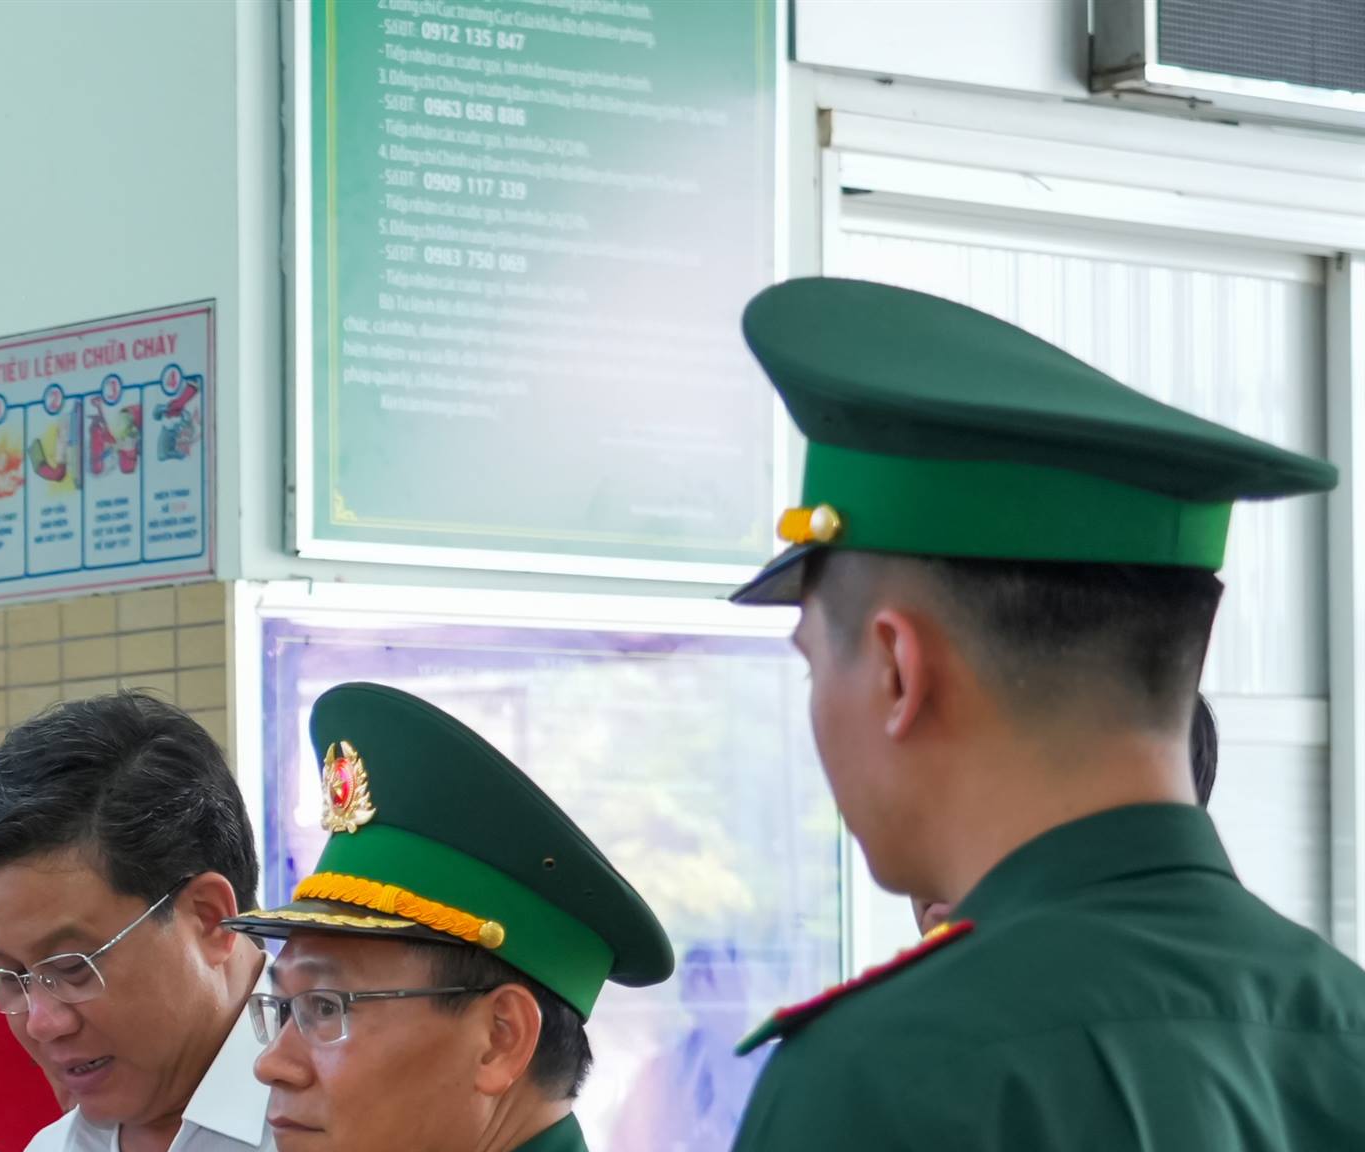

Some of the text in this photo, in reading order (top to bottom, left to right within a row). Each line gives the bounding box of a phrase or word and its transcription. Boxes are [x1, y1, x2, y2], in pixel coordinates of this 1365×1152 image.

[422, 21, 460, 41] 0912
[465, 26, 492, 46] 135
[467, 177, 494, 195] 117
